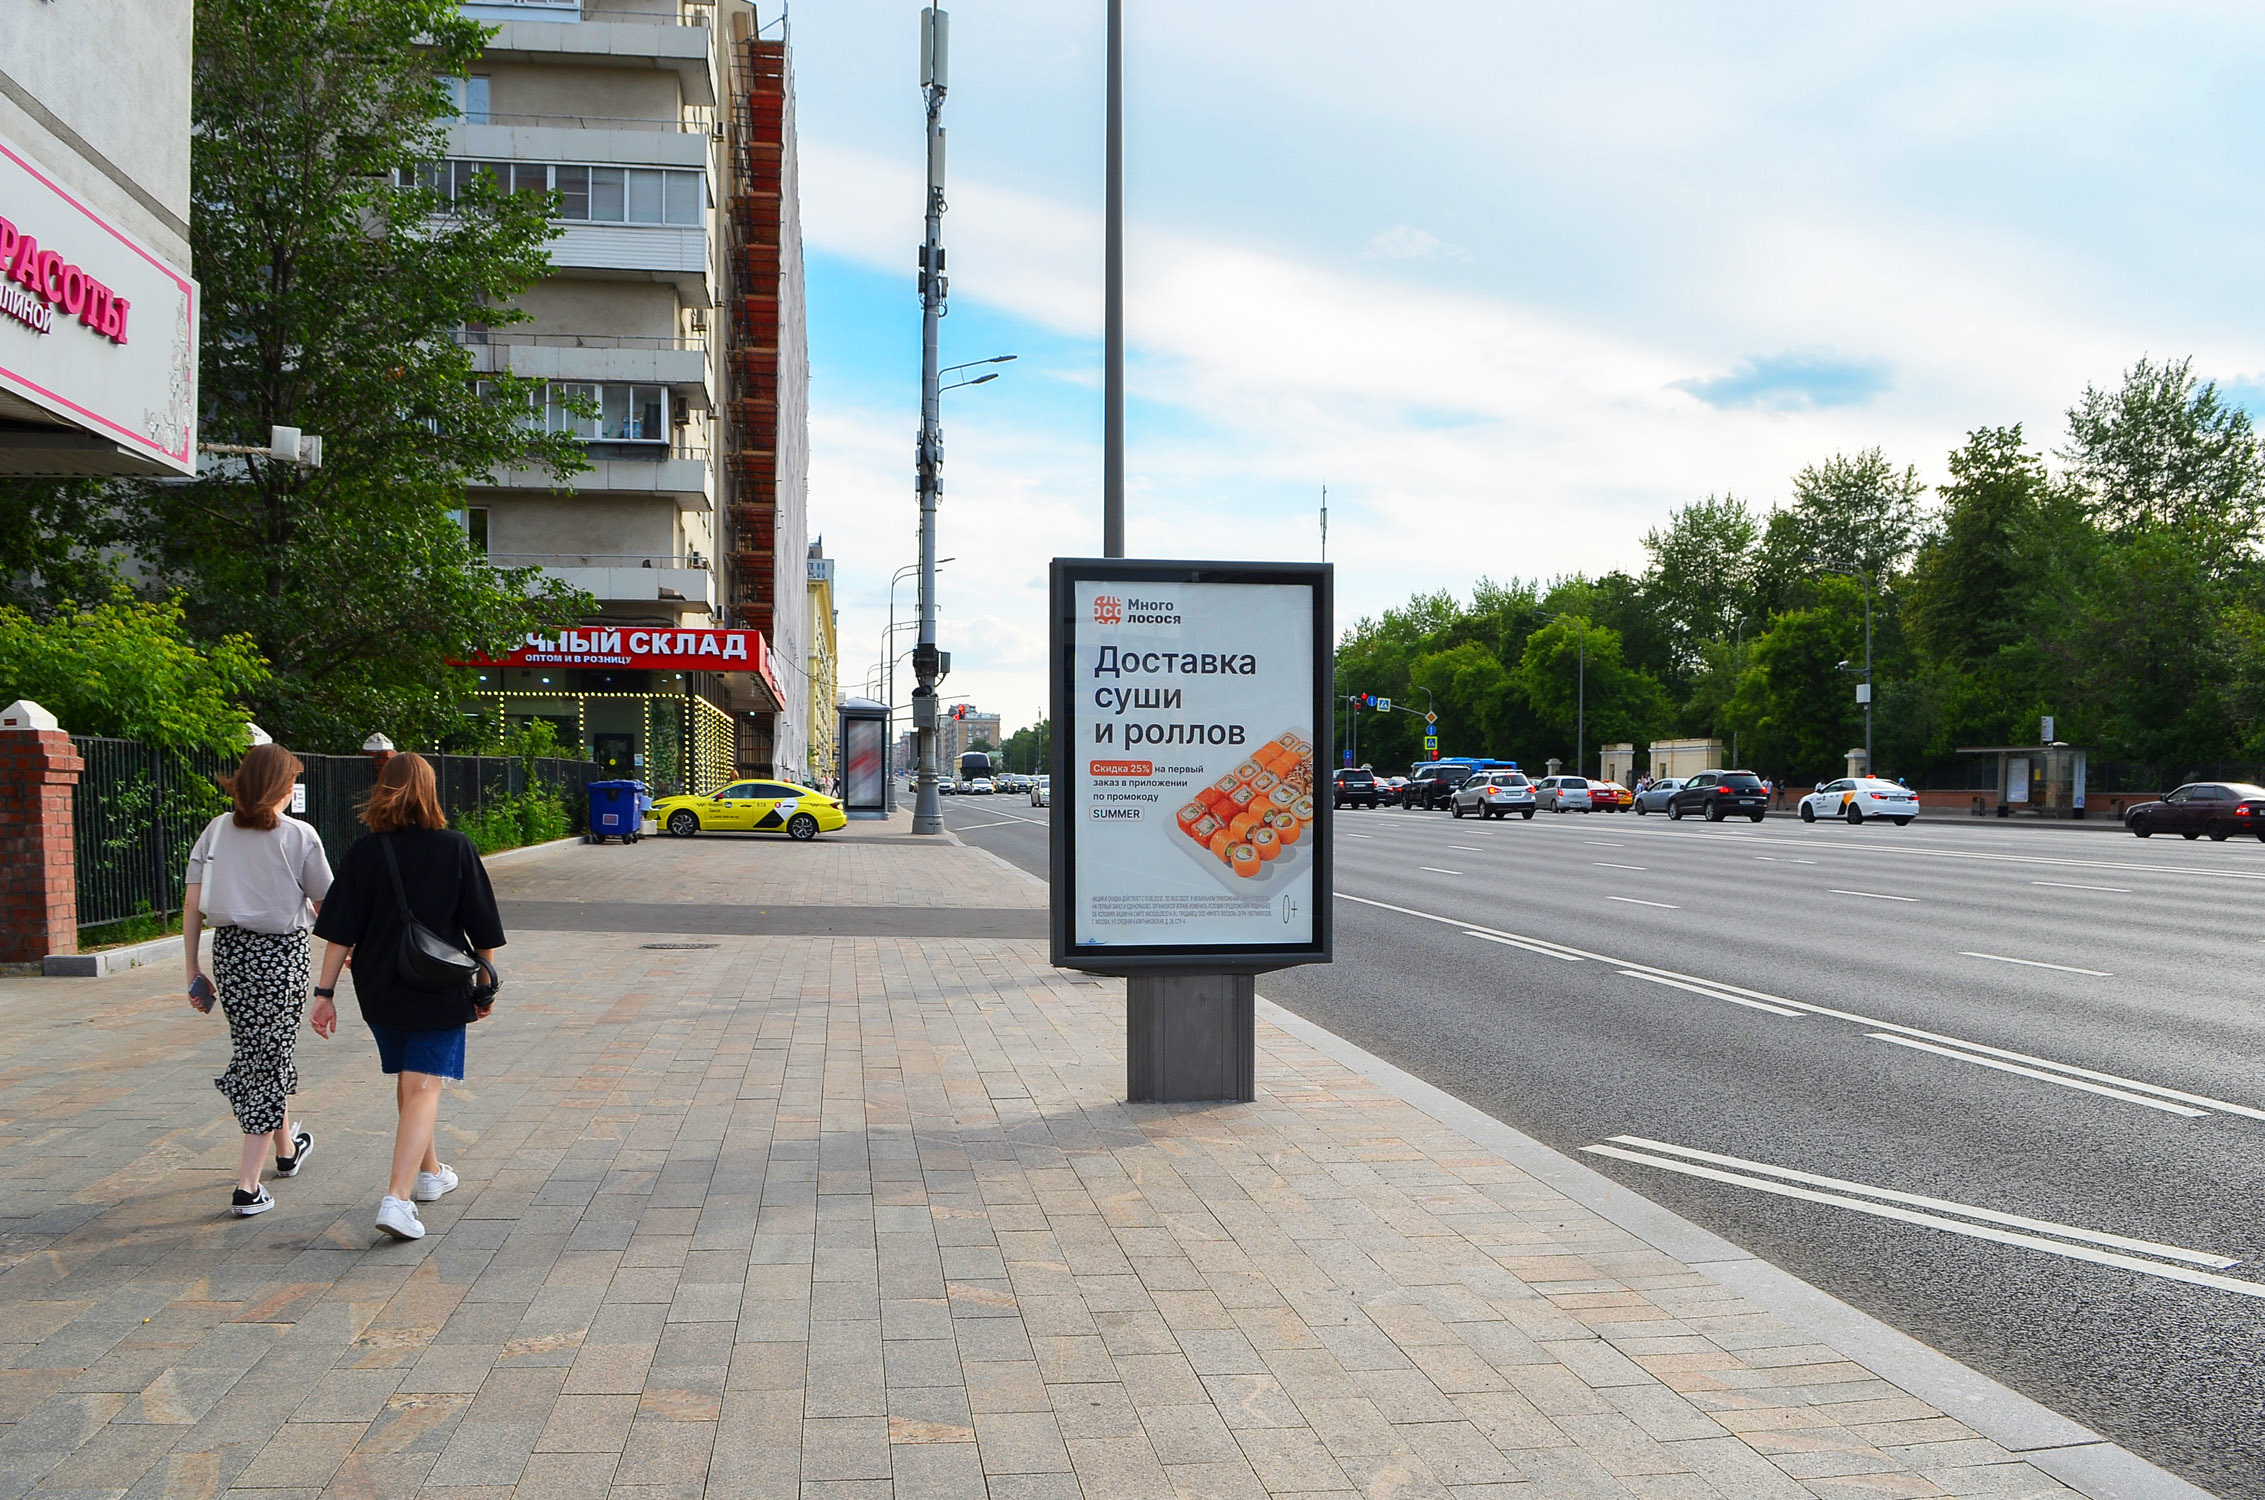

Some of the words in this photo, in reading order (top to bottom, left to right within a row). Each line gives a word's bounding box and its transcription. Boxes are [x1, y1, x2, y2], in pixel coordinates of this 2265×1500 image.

[0, 282, 54, 335] ЛИНОЙ
[1127, 599, 1174, 611] Много
[1127, 614, 1181, 625] лосося
[629, 632, 748, 660] СКЛАД
[525, 654, 562, 662] ОПТОМ
[574, 655, 581, 663] В
[583, 655, 632, 665] РОЗНИЦУ
[1094, 646, 1257, 678] Доставка
[1094, 687, 1182, 715] суши
[1095, 724, 1113, 744] и
[1125, 724, 1246, 751] роллов
[1093, 764, 1129, 774] Скидка
[1130, 764, 1150, 773] 25%
[1168, 765, 1204, 775] первый
[1129, 780, 1188, 788] приложении
[1107, 794, 1159, 803] промокоду
[1093, 809, 1140, 818] SUMMER
[1282, 894, 1298, 924] 0+
